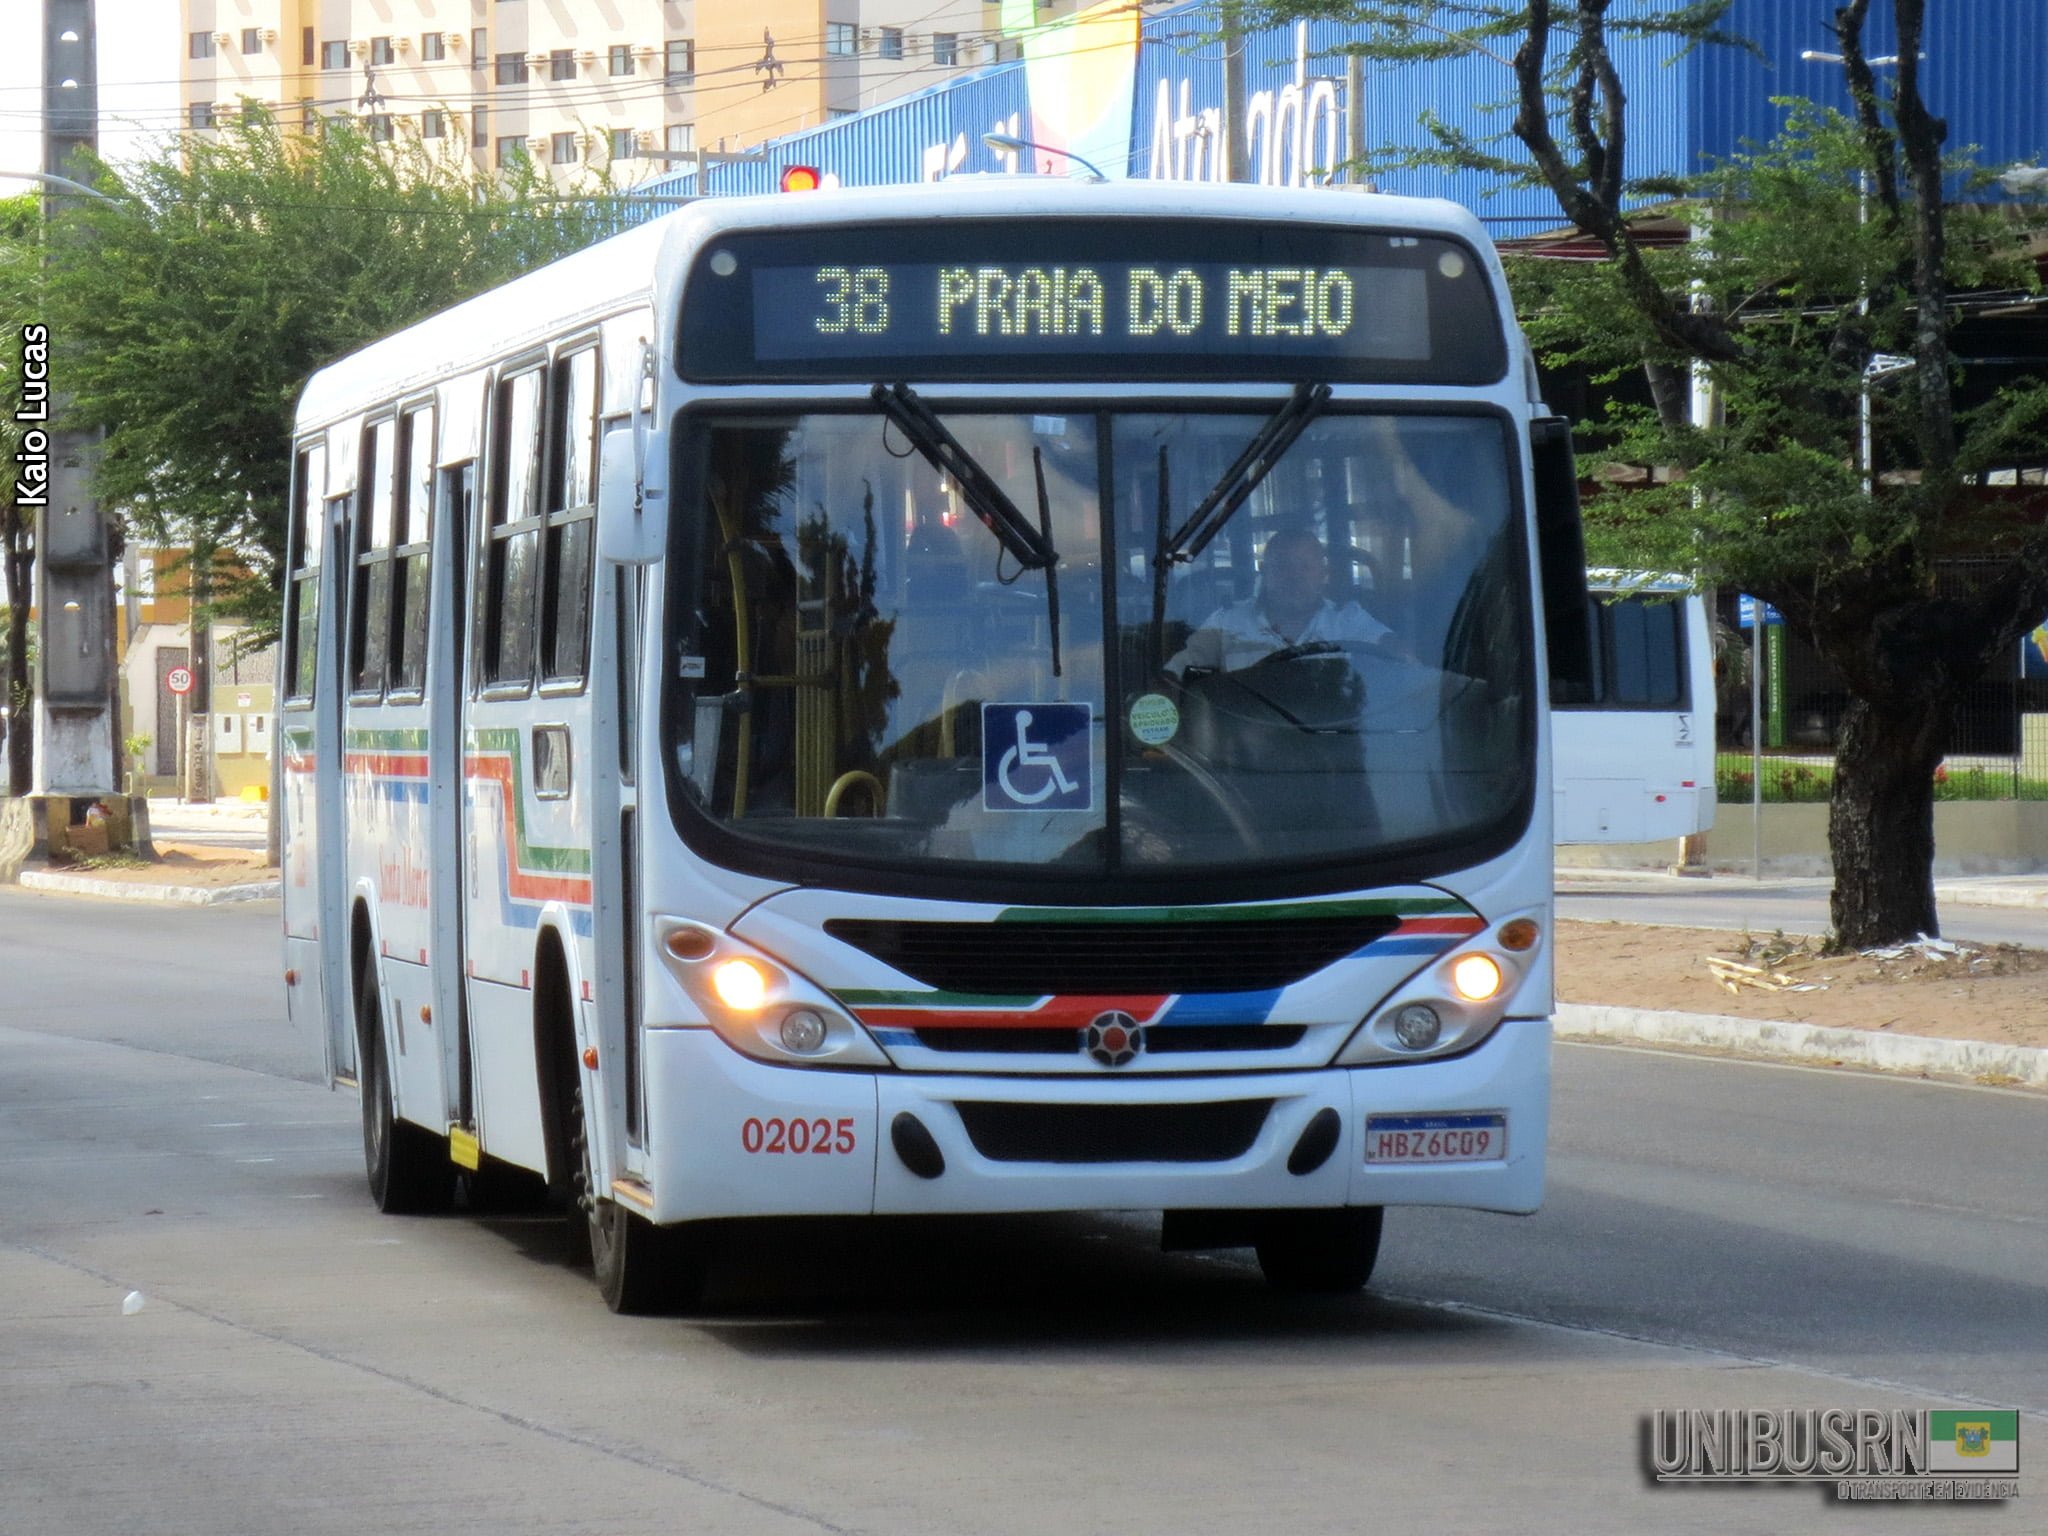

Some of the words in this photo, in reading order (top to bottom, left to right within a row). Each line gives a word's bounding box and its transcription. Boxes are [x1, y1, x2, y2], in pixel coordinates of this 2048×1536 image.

[815, 267, 889, 333] 38
[938, 268, 1103, 336] PRAIA
[1128, 268, 1202, 336] DO
[1228, 268, 1353, 336] MEIO
[171, 672, 189, 684] 50
[742, 1117, 856, 1155] 02025
[1379, 1131, 1490, 1158] HBZ6C09
